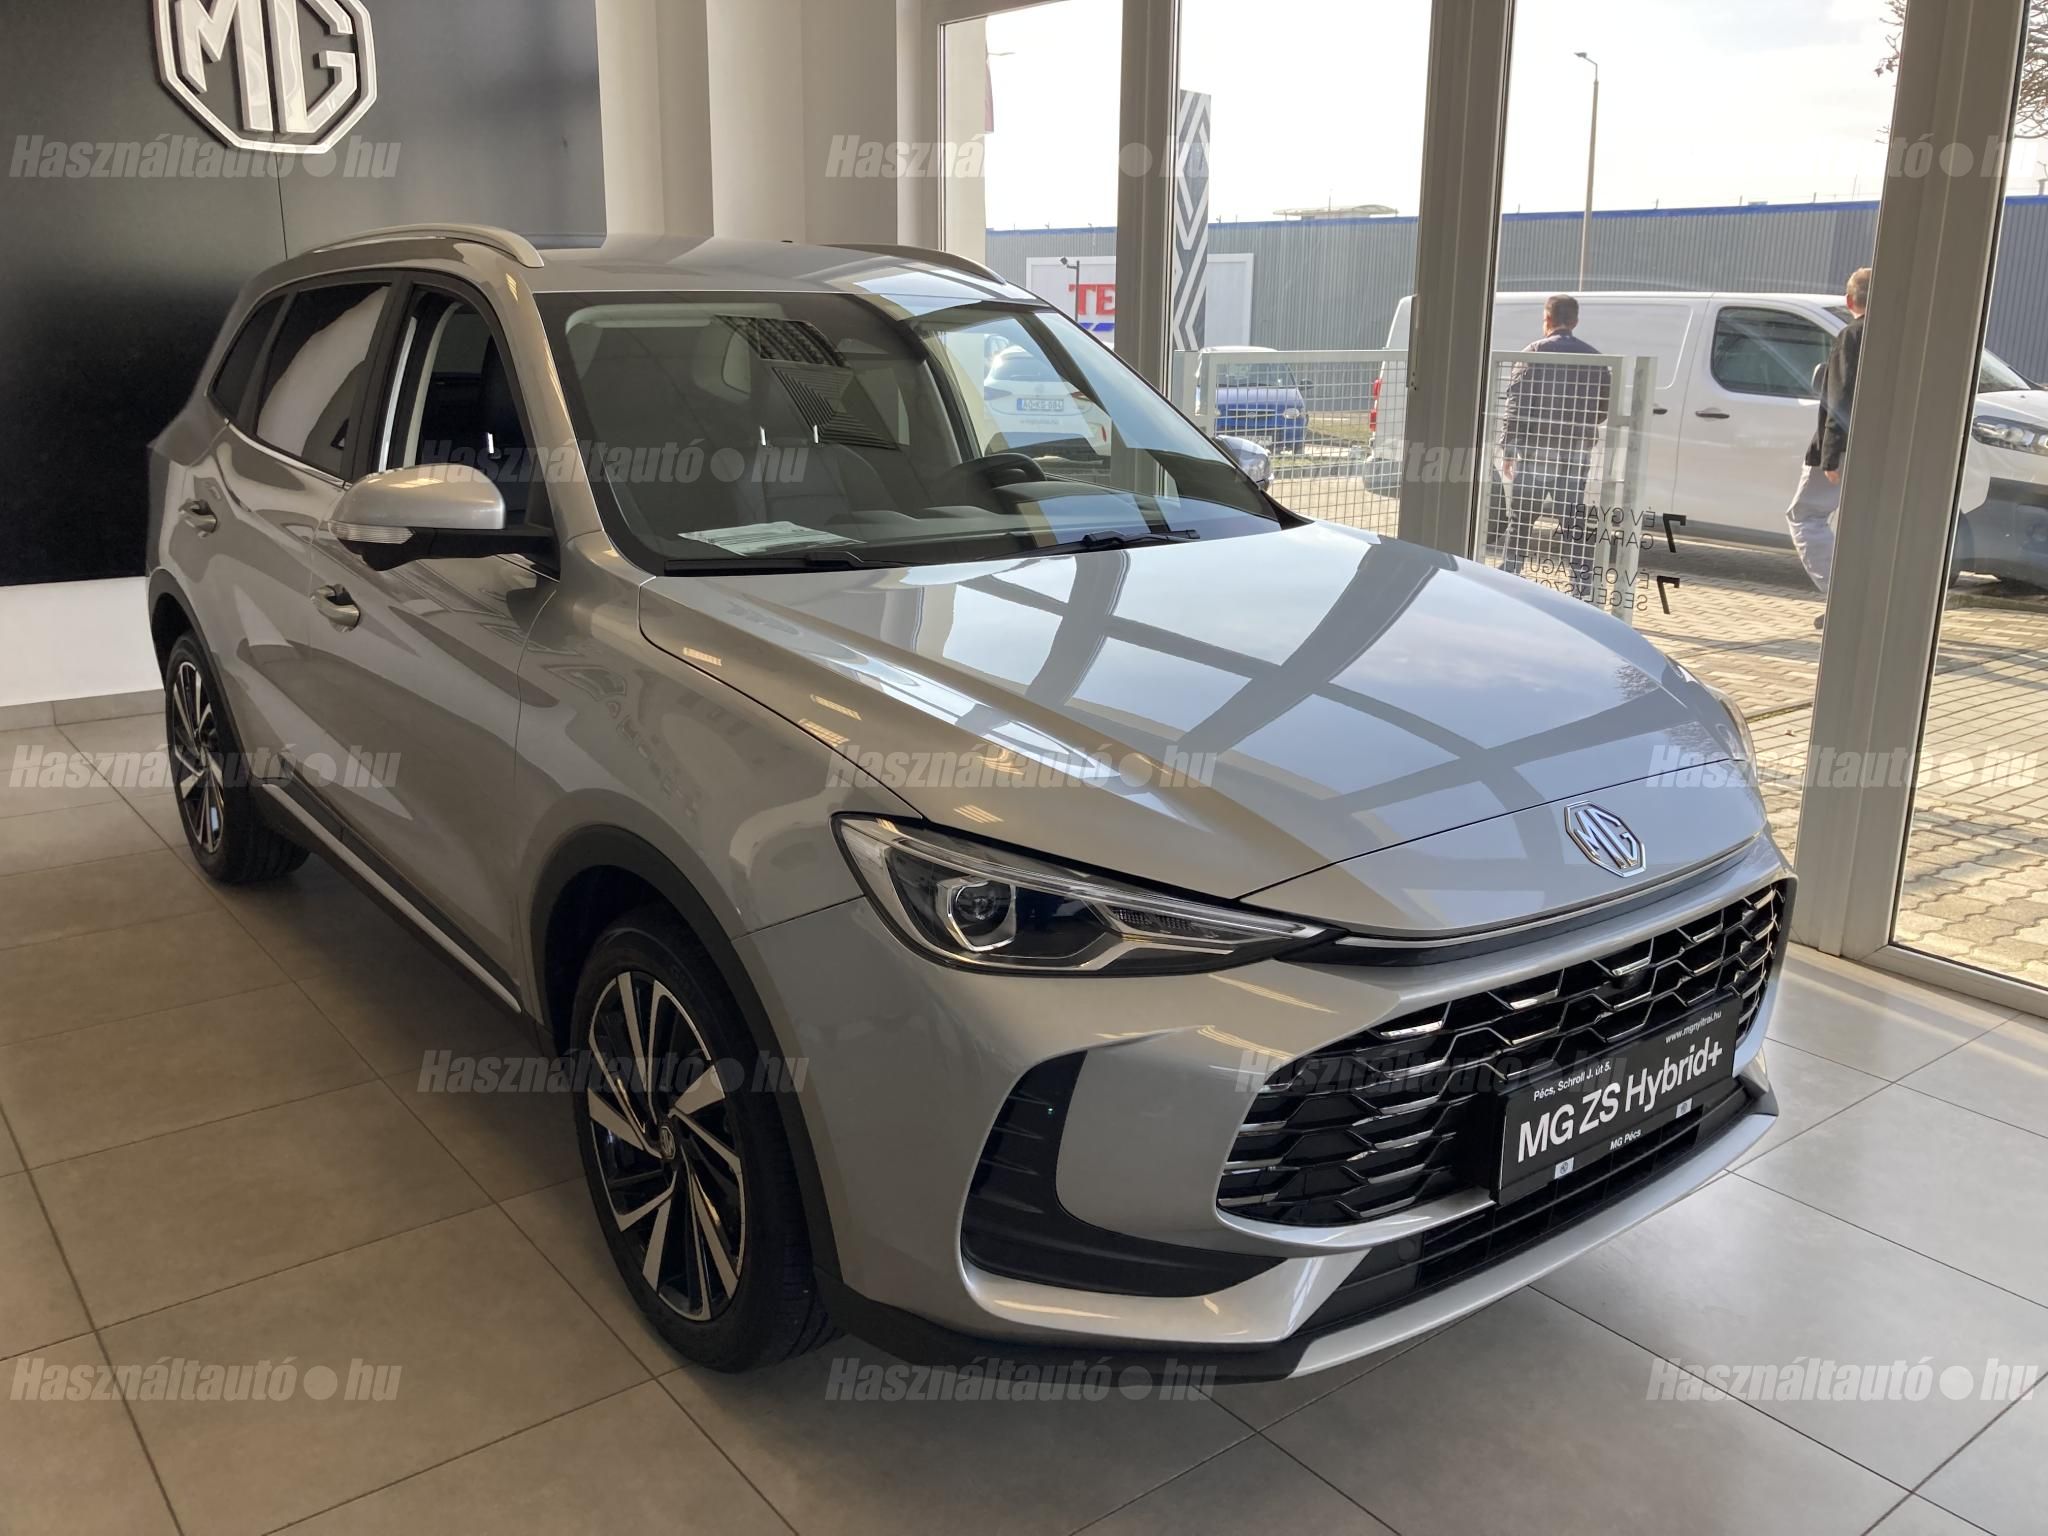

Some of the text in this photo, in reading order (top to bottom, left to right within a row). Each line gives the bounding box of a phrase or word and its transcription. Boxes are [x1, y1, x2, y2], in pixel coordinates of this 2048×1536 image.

[175, 0, 358, 134] MG
[1068, 283, 1116, 315] TE
[1571, 805, 1639, 869] MG
[1518, 1036, 1723, 1163] MG ZS Hybrid+
[1533, 1086, 1556, 1102] Pécs,
[1557, 1071, 1586, 1091] Schroll
[1586, 1068, 1594, 1080] J.
[1595, 1064, 1604, 1076] út
[1610, 1129, 1642, 1151] MG Pécs
